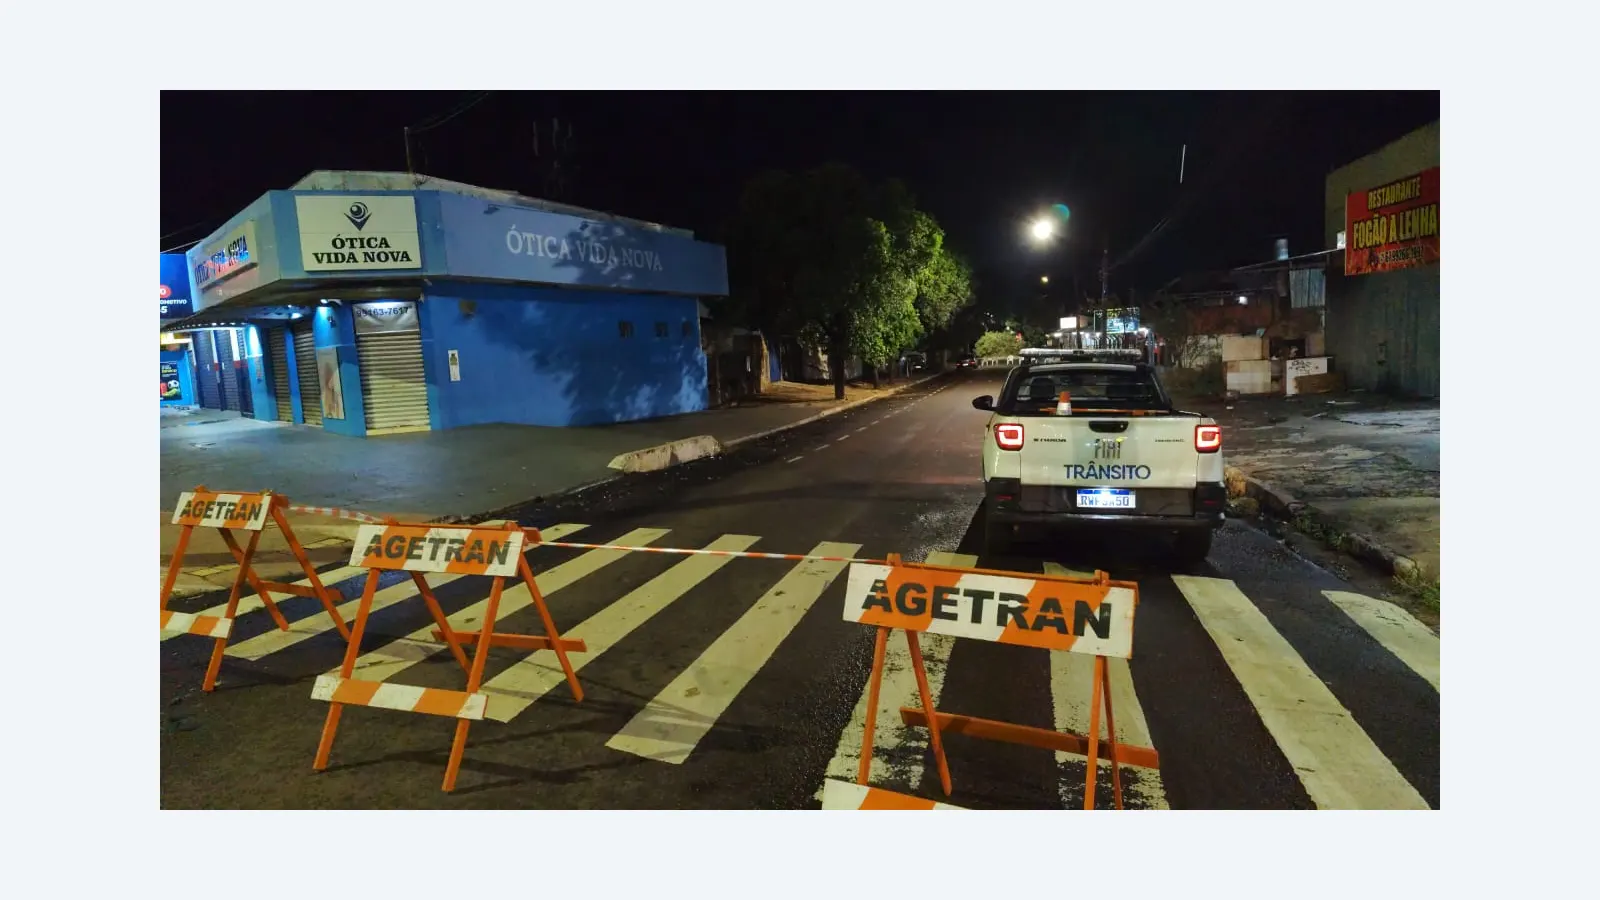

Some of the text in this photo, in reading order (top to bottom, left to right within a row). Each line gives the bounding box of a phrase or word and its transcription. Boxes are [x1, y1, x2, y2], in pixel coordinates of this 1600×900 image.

[1368, 178, 1421, 210] RESTAURANTE
[331, 234, 391, 249] ÓTICA
[1353, 204, 1437, 249] FOGÃO A LENHA
[312, 251, 413, 264] VIDA NOVA
[506, 224, 663, 271] ÓTICA VIDA NOVA
[1063, 461, 1151, 480] TRÂNSITO
[179, 499, 261, 522] AGETRAN
[363, 534, 512, 565] AGETRAN
[861, 578, 1112, 640] AGETRAN
